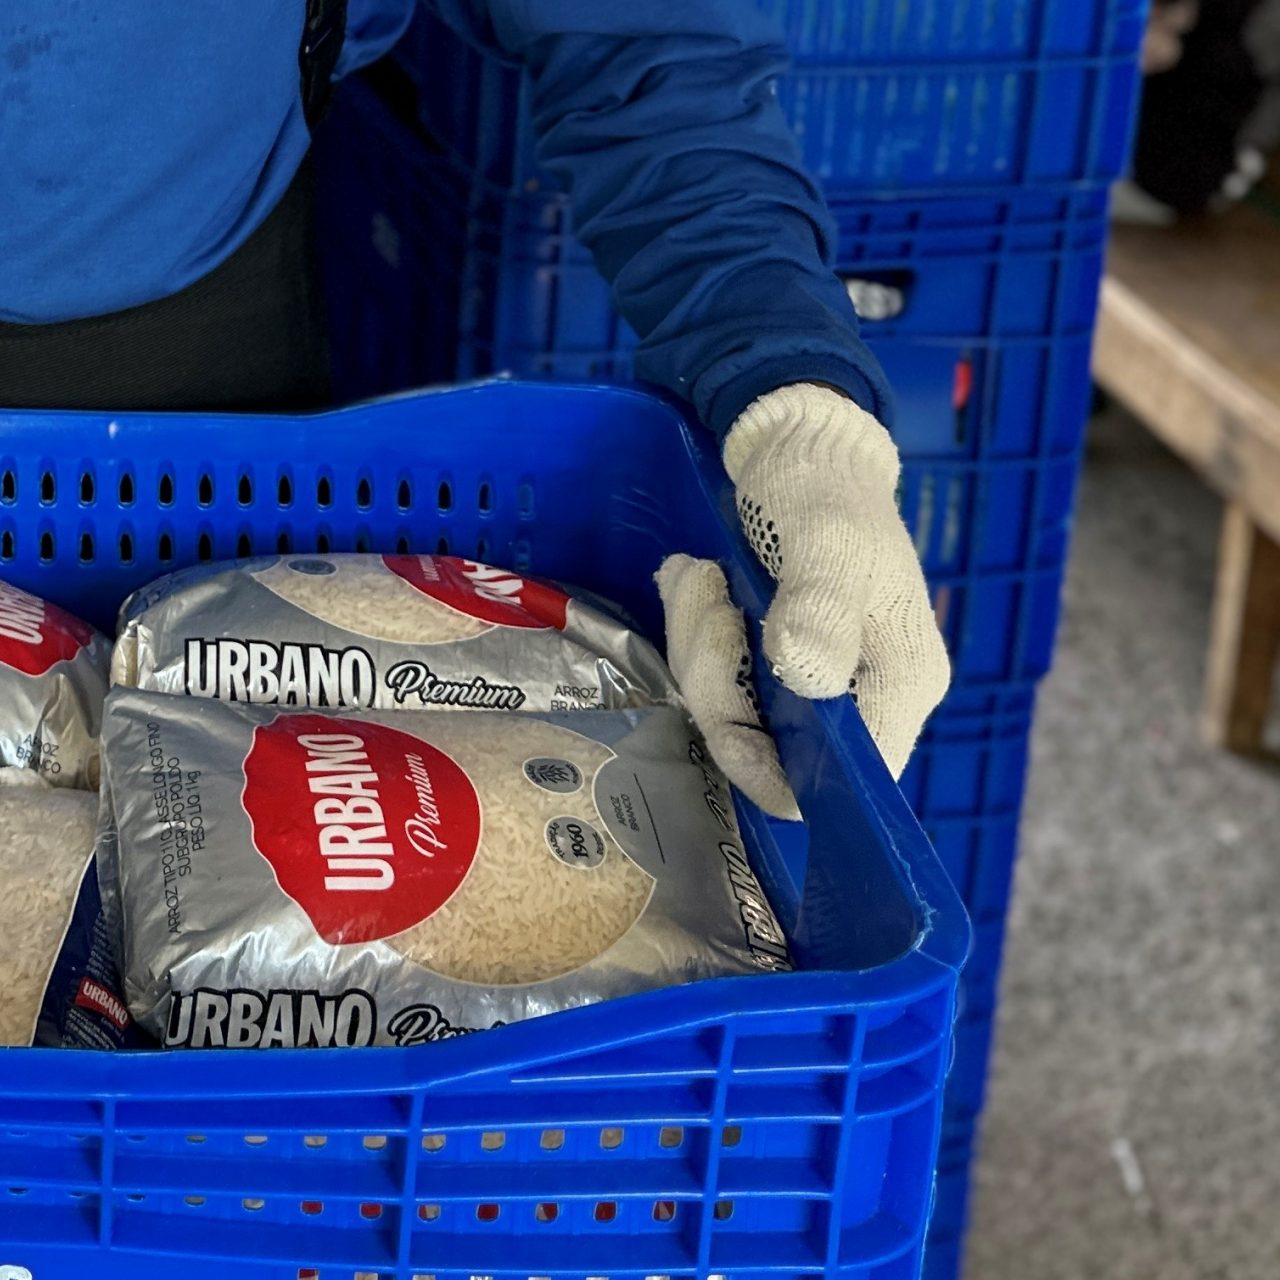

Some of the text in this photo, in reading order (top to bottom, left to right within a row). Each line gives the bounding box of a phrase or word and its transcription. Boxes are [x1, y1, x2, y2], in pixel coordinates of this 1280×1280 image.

[183, 637, 528, 710] URBANO Premium
[554, 684, 599, 699] ARROZ
[146, 721, 161, 747] FINO
[150, 747, 168, 788] LONGO
[154, 787, 174, 842] CLASSE
[166, 757, 191, 877] SUBGRUPO POLIDO
[297, 732, 395, 892] URBANO
[404, 750, 448, 859] Premium
[609, 795, 627, 827] ARROZ
[620, 793, 640, 833] BRANCO
[189, 815, 206, 852] PESO
[565, 823, 589, 858] 1960
[160, 854, 177, 887] TIPO
[163, 886, 182, 934] ARROZ
[82, 981, 130, 1026] URBANO
[164, 987, 377, 1048] URBANO
